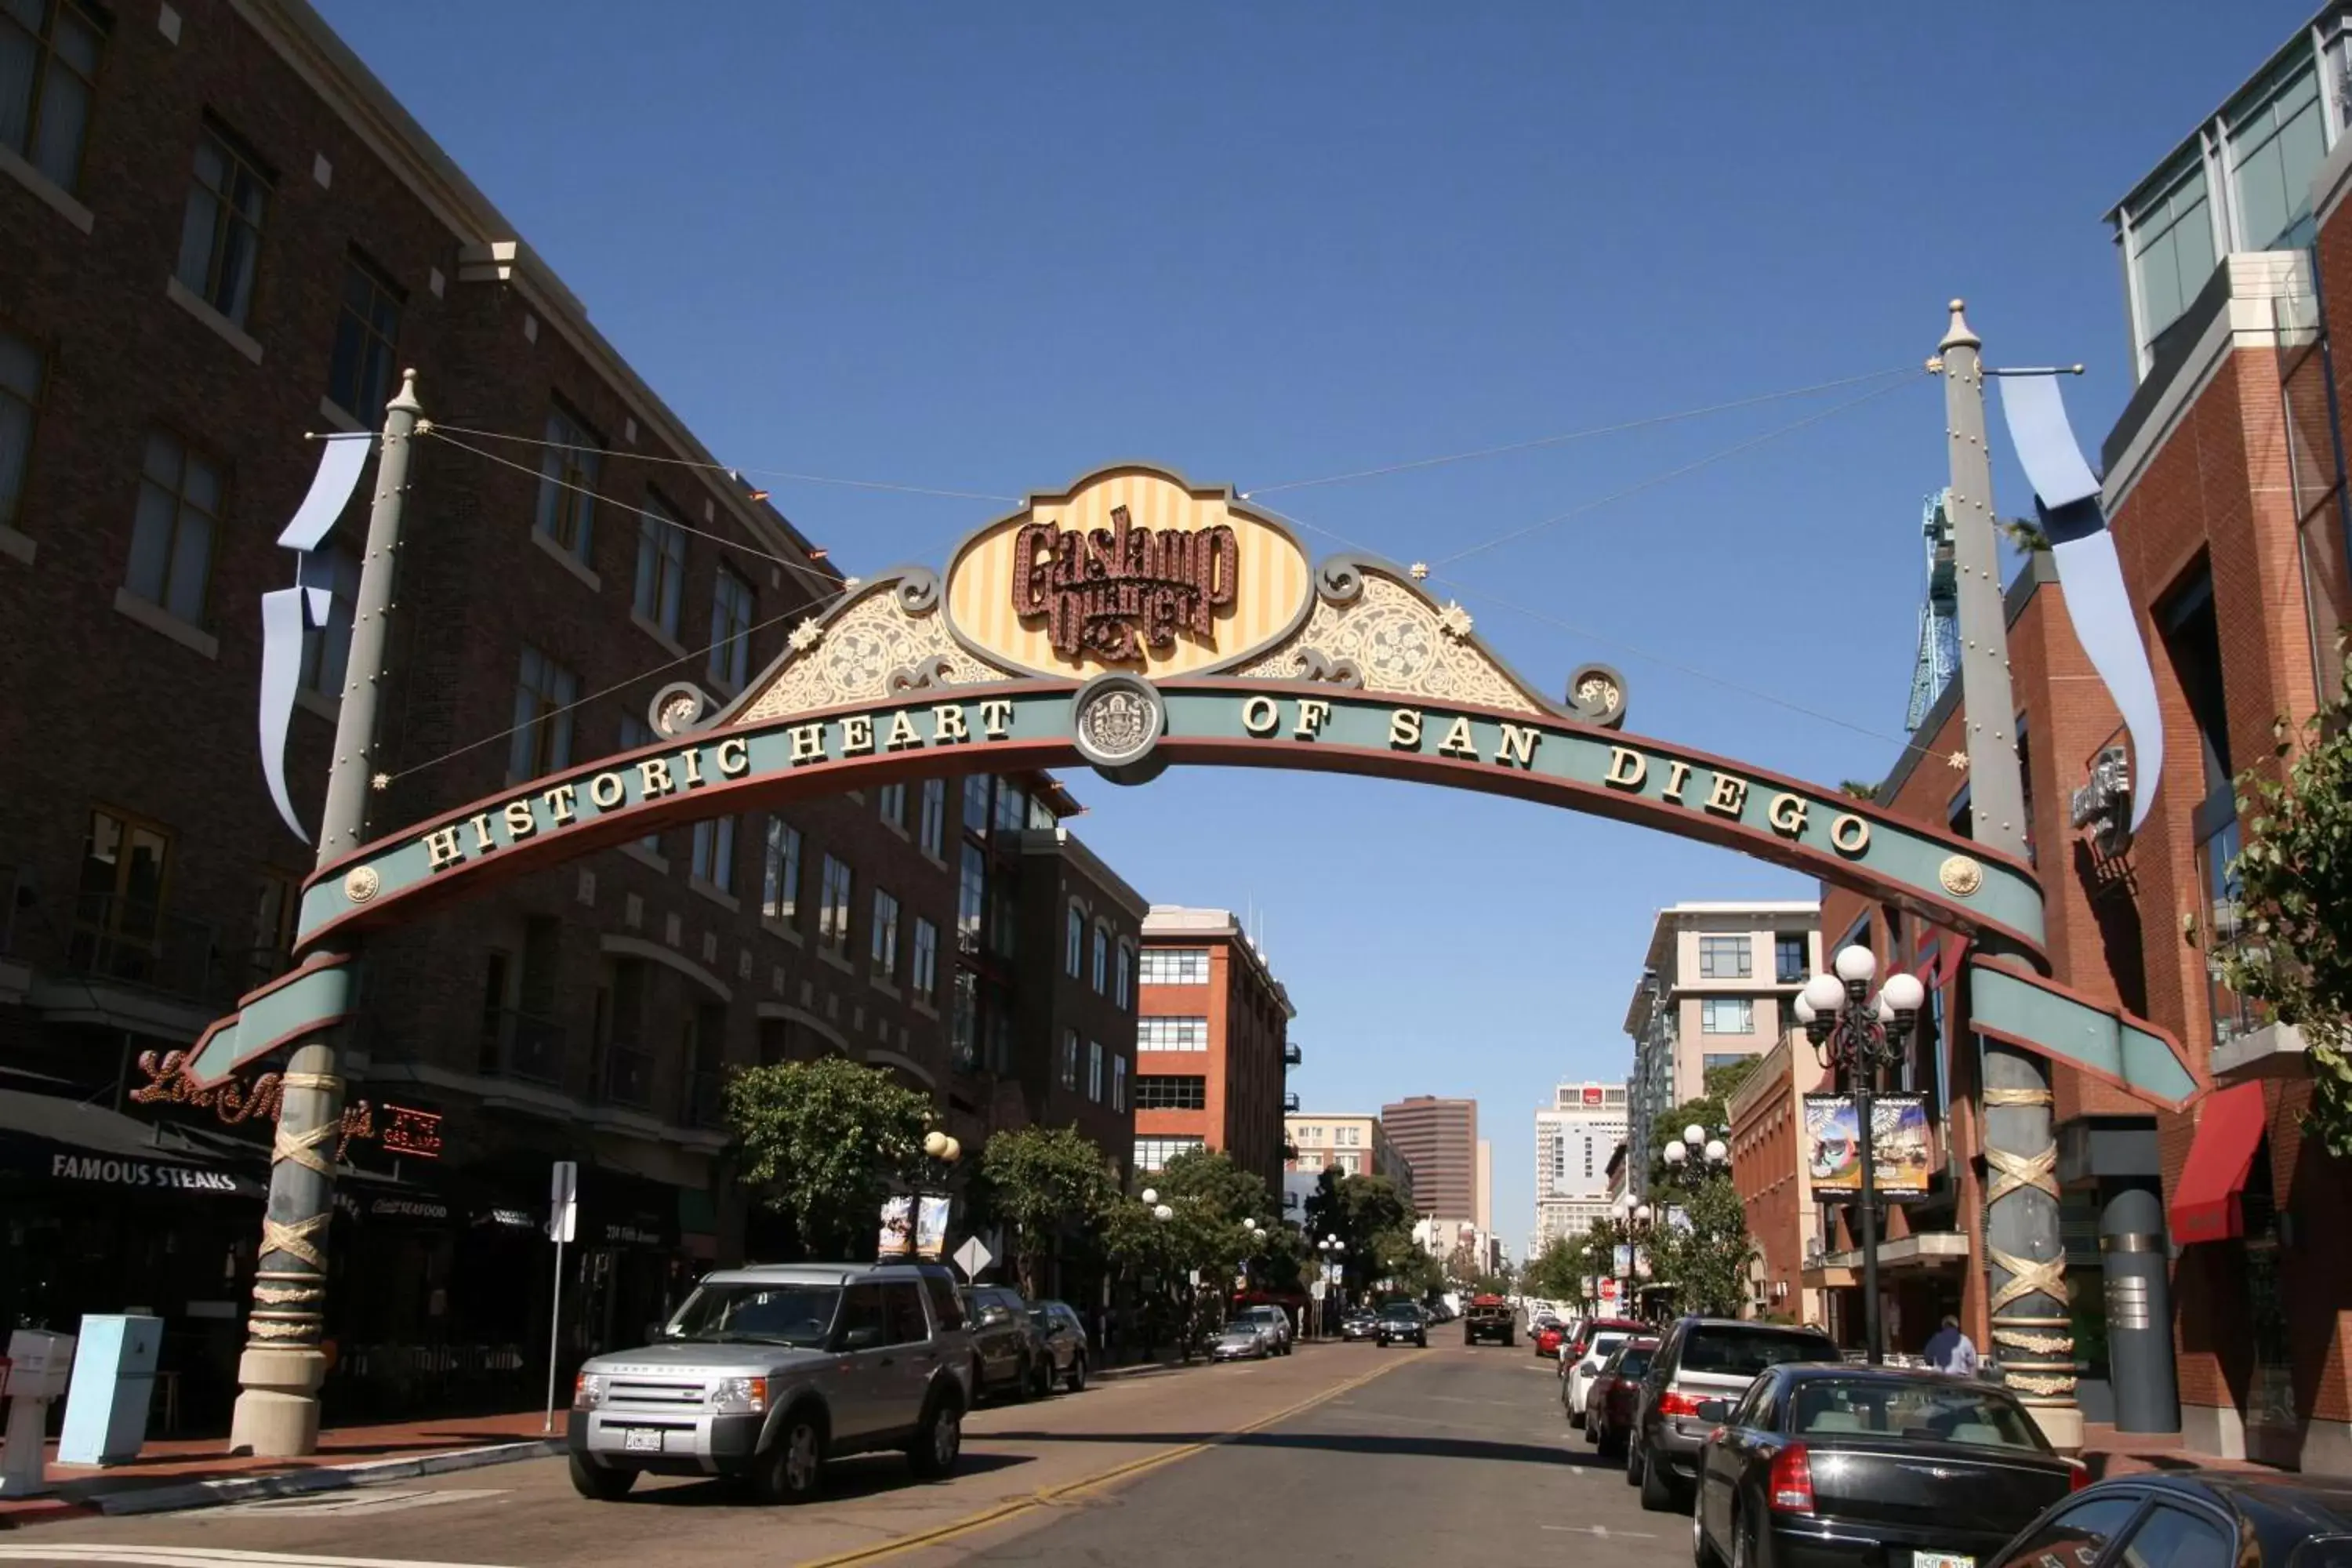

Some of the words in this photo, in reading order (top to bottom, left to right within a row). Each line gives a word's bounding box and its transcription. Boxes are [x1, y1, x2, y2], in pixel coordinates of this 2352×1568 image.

[1014, 505, 1239, 633] Gaslamp
[1048, 579, 1213, 660] Quarter
[422, 738, 749, 868] HISTORIC
[788, 699, 1013, 762] HEART
[1242, 695, 1330, 735] OF
[1388, 708, 1541, 763] SAN
[1606, 746, 1871, 851] DIEGO
[52, 1154, 151, 1185] FAMOUS
[154, 1167, 237, 1191] STEAKS
